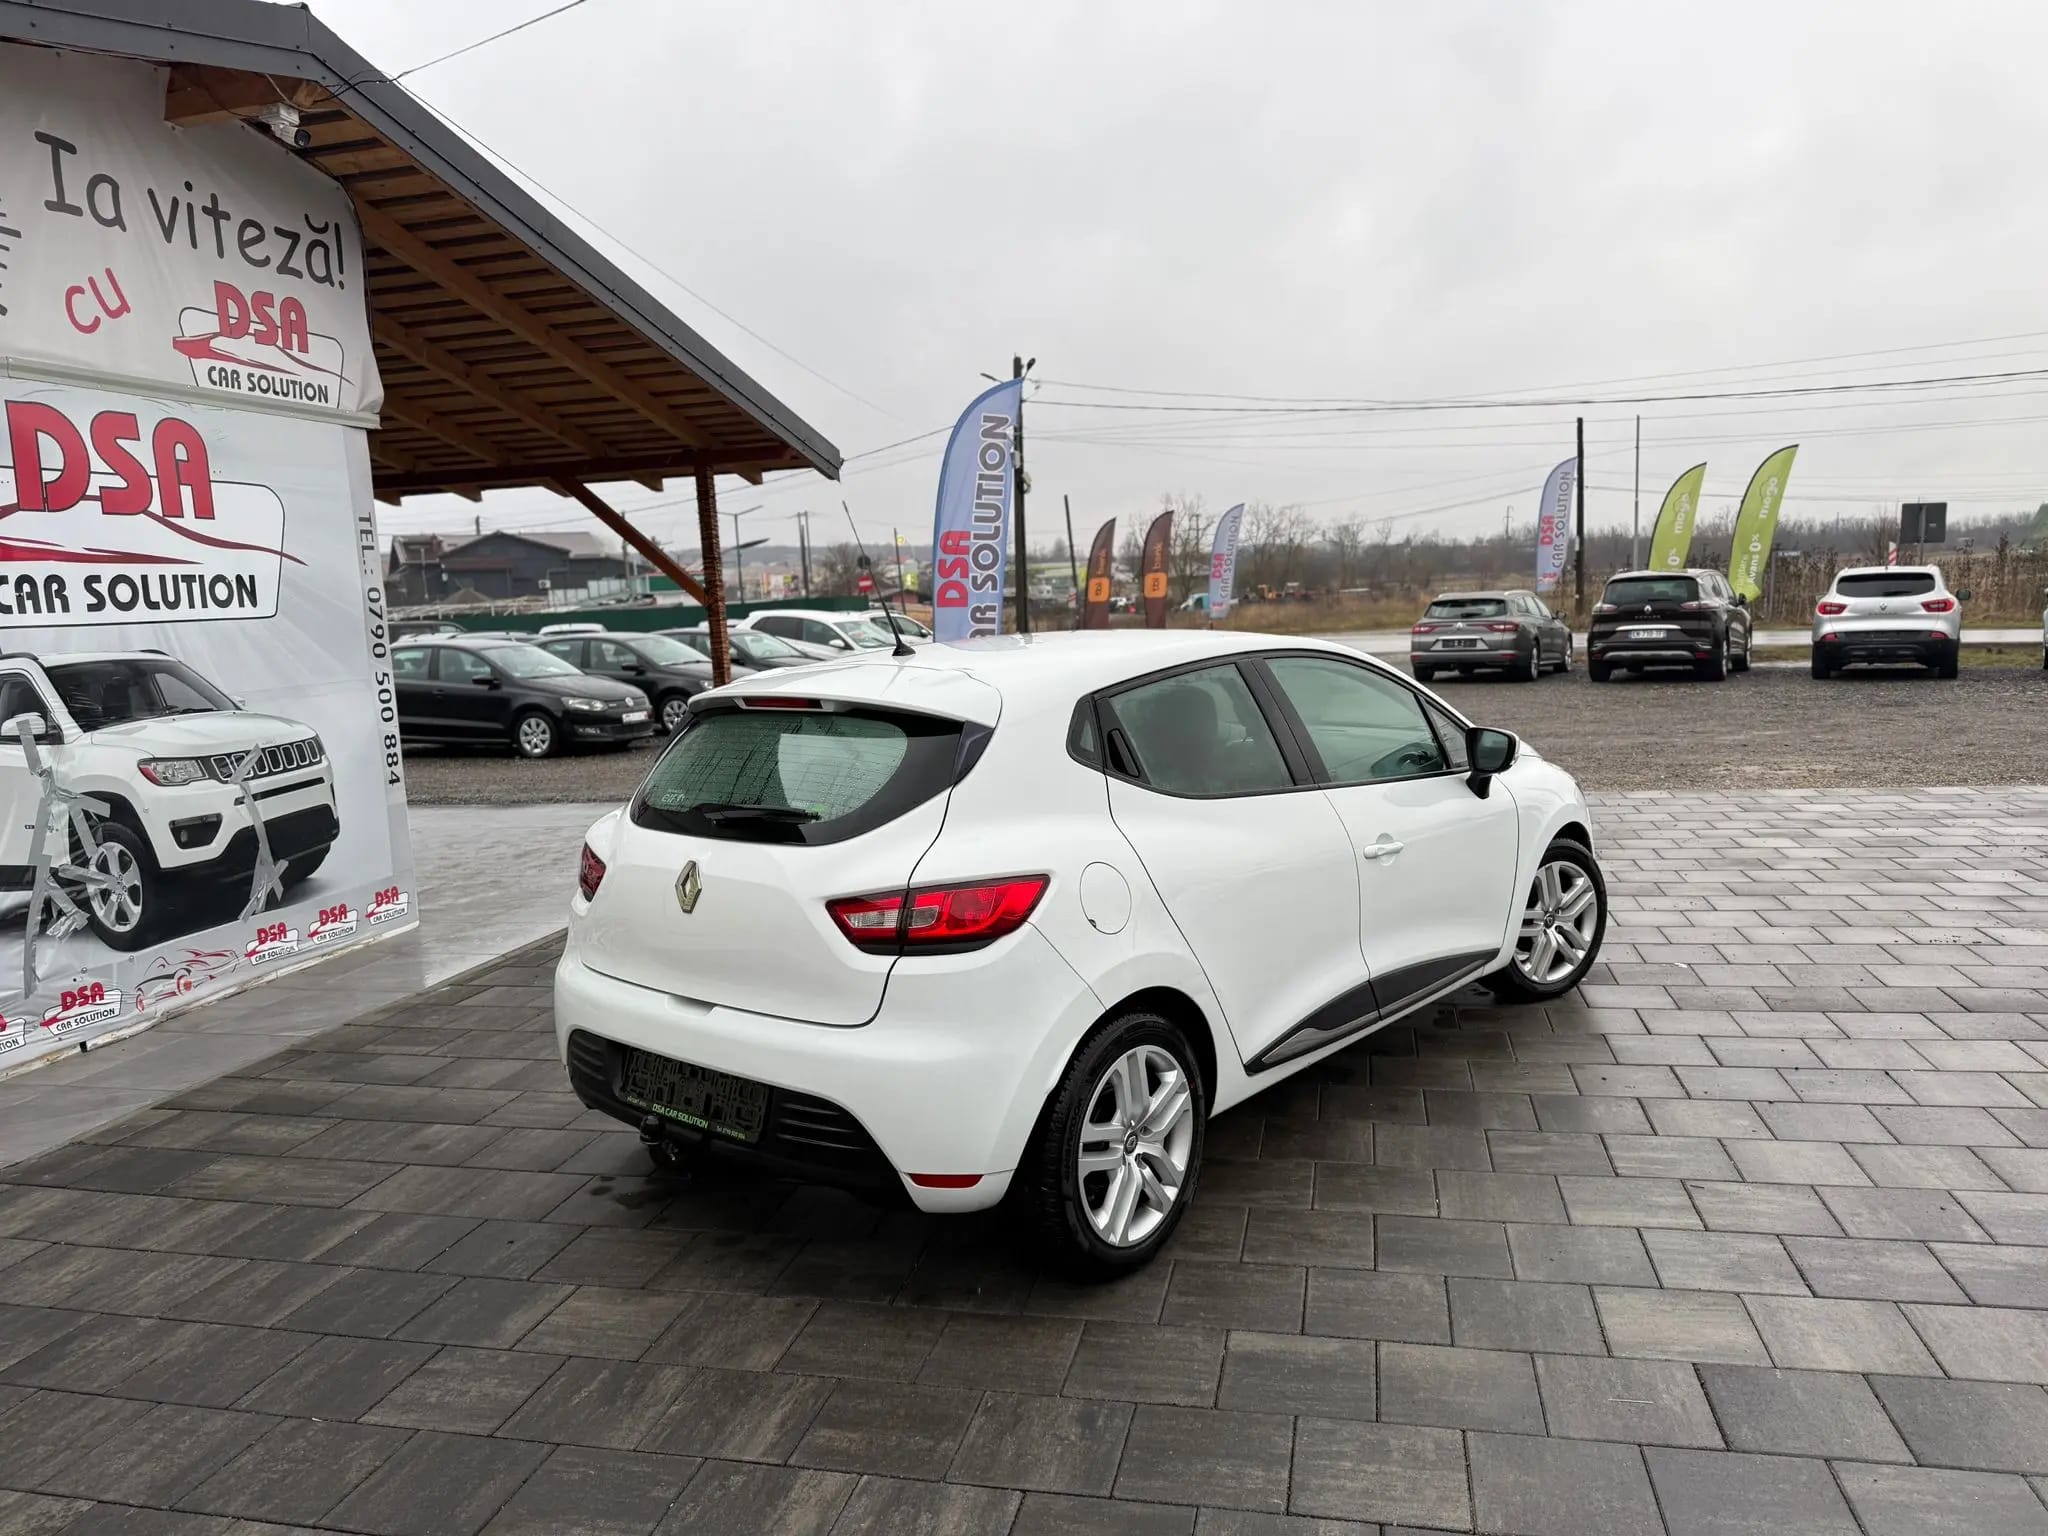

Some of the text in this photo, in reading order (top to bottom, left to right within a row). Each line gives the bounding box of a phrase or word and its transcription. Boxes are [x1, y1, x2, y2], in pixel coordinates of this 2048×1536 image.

[34, 130, 345, 290] Ia viteză!
[65, 267, 131, 334] cu
[213, 279, 310, 354] DSA
[207, 365, 329, 404] CAR SOLUTION
[6, 399, 216, 520] DSA
[970, 412, 1010, 593] SOLUTION
[1552, 471, 1571, 569] CAR SOLUTION
[1541, 515, 1555, 546] DSA
[936, 530, 971, 608] DSA
[84, 573, 259, 613] SOLUTION
[366, 586, 388, 660] 0790
[375, 670, 395, 724] 500
[383, 733, 401, 787] 884
[318, 903, 348, 926] DSA
[375, 886, 400, 908] DSA
[256, 921, 288, 945] DSA
[316, 926, 354, 942] CAR SOLUTION
[254, 953, 267, 963] CAR
[55, 1007, 116, 1032] CAR SOLUTION
[61, 980, 105, 1013] DSA
